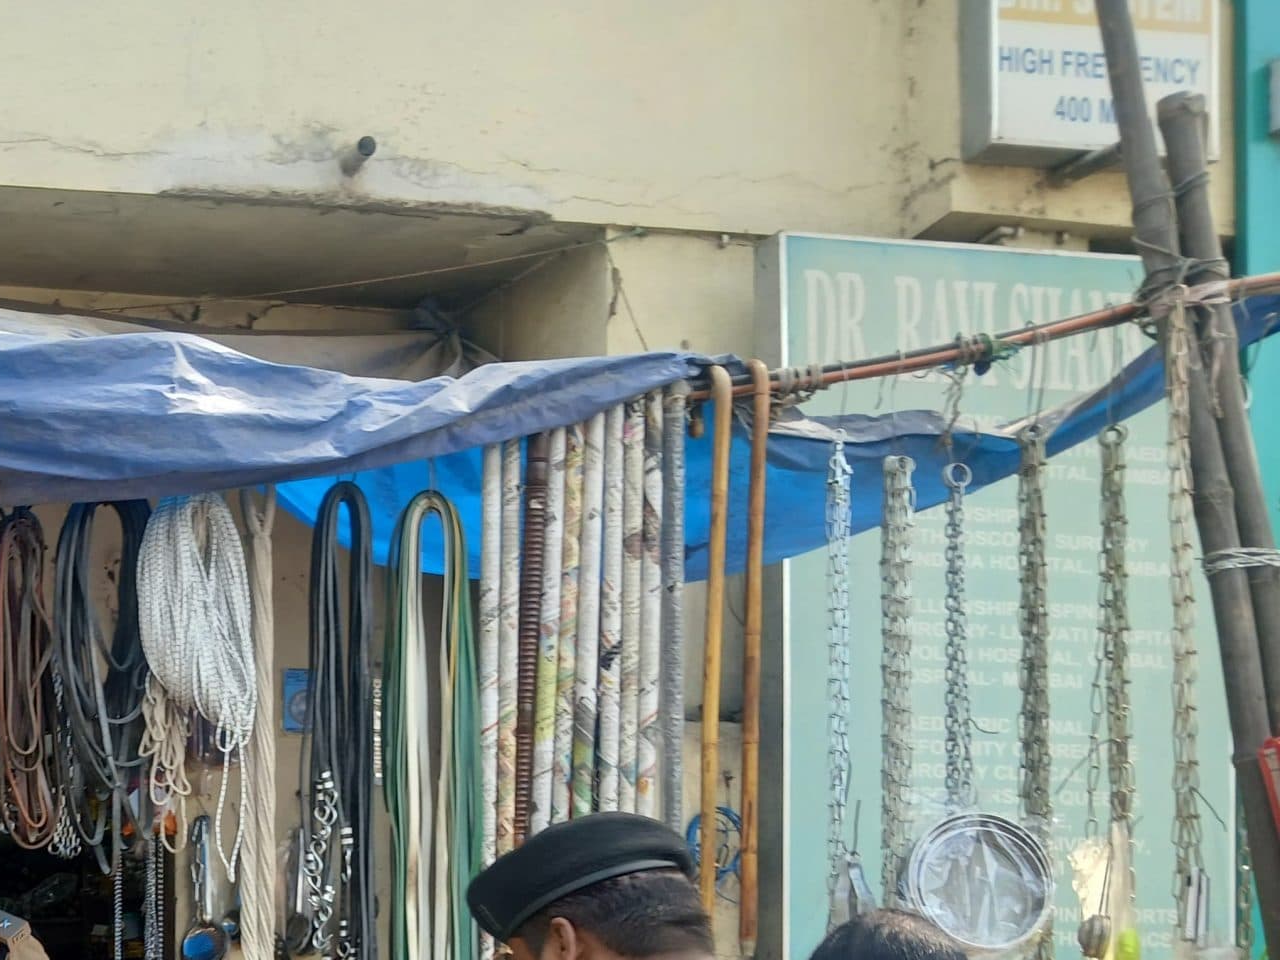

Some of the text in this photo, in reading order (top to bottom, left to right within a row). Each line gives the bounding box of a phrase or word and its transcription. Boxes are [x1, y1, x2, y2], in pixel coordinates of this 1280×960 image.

[999, 47, 1200, 85] HIGH FREENCY
[1055, 96, 1092, 123] 400
